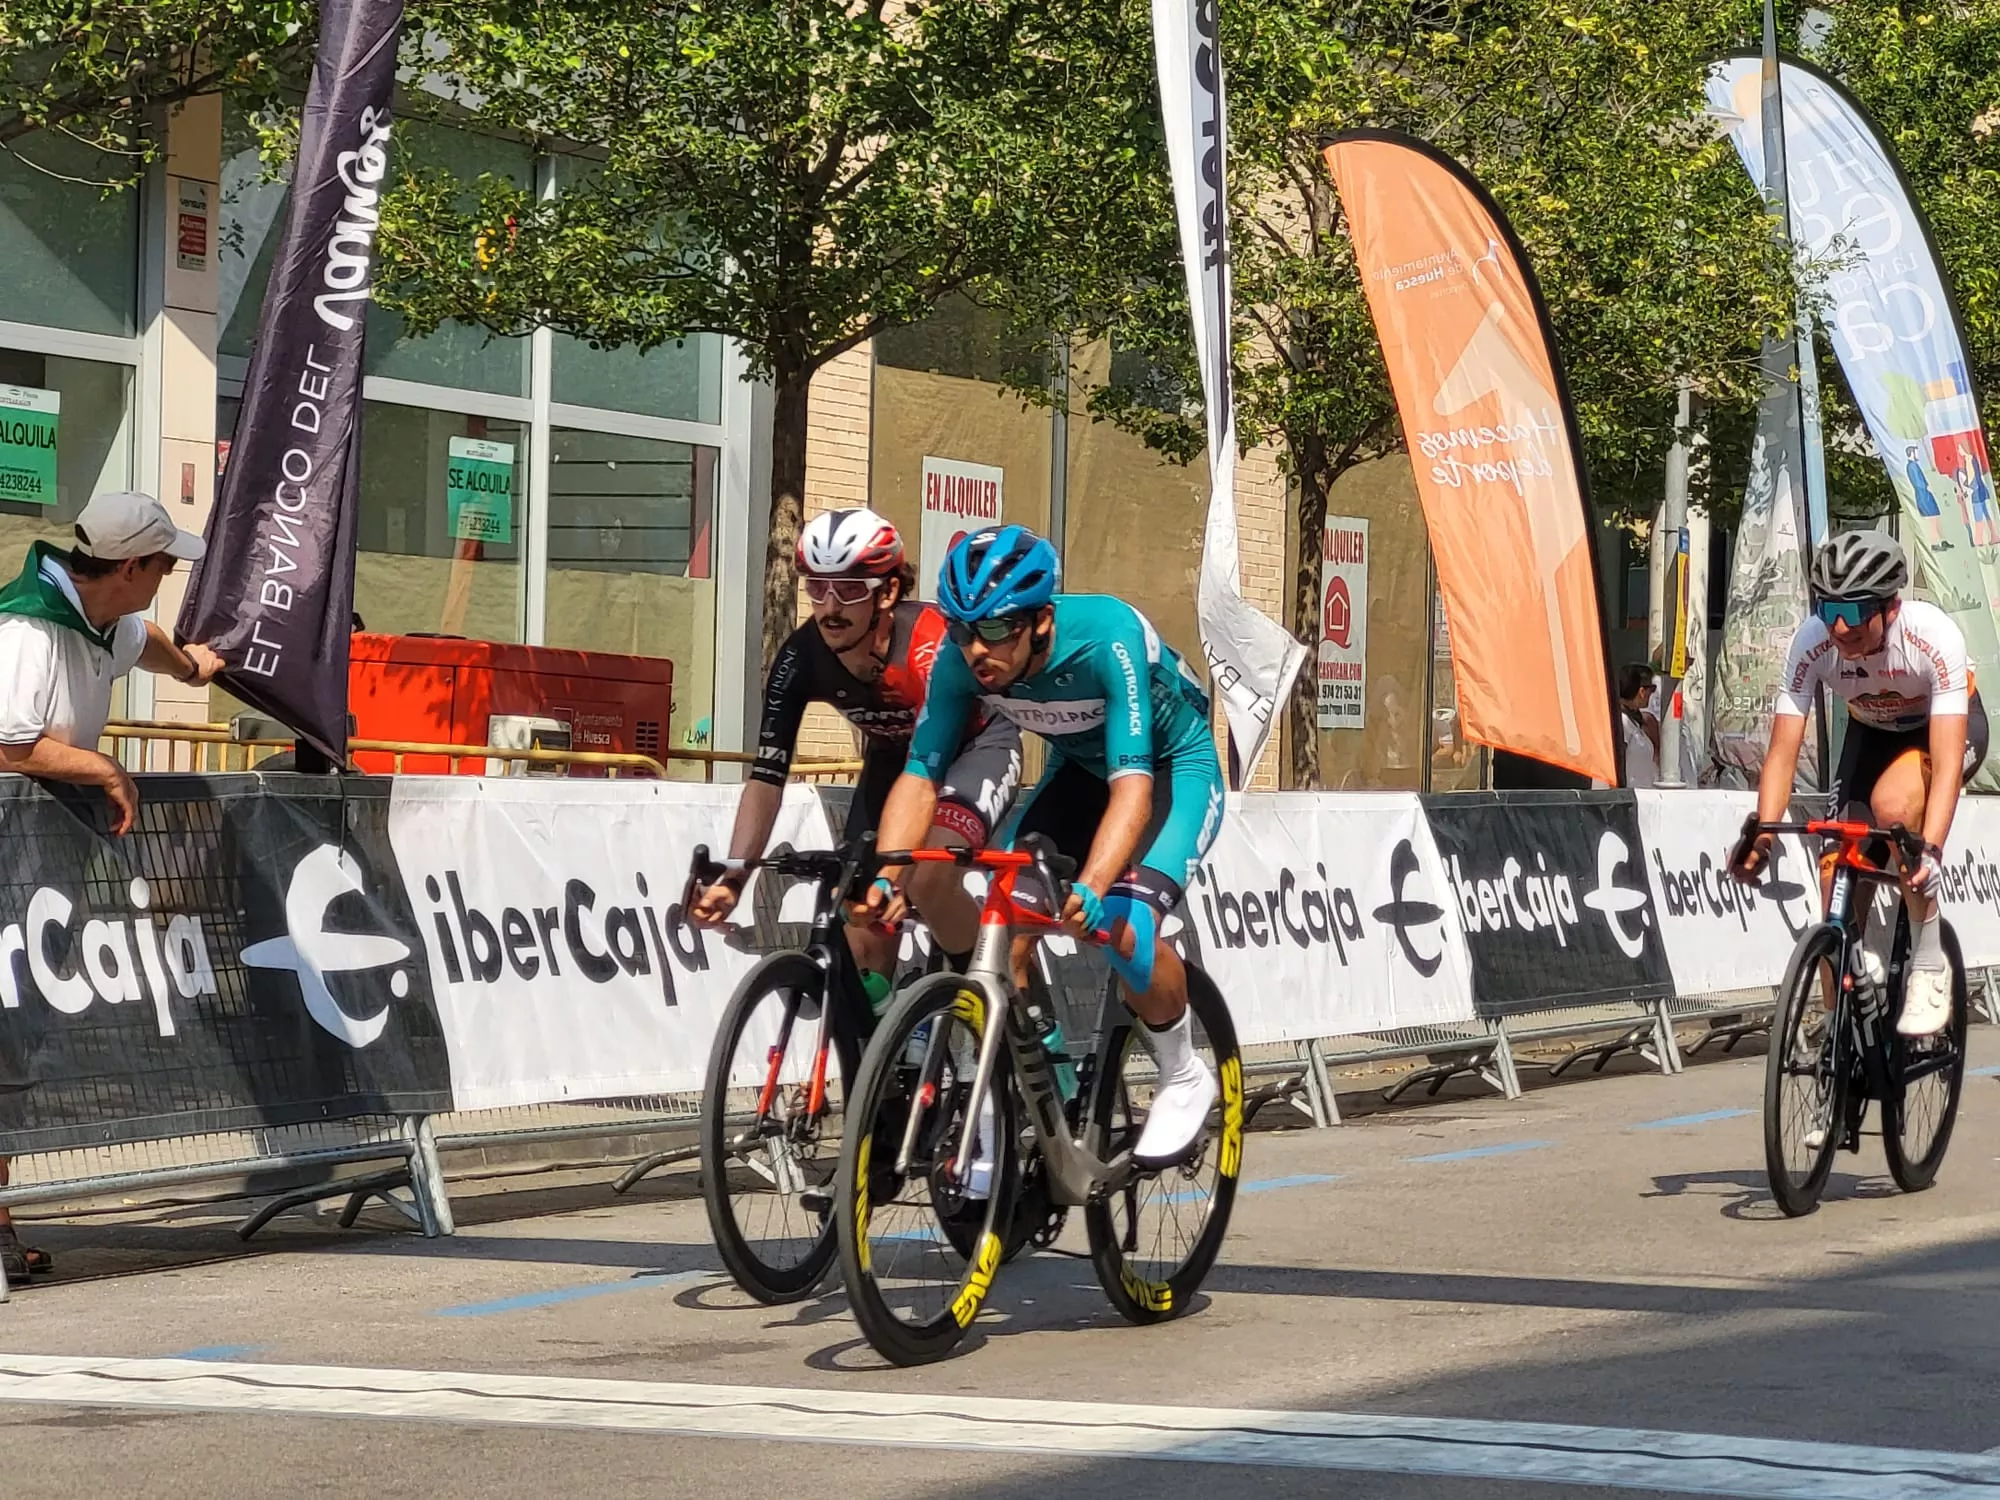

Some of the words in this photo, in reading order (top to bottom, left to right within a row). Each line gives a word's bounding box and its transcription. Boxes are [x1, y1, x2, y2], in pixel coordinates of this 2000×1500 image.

[448, 468, 464, 489] SE
[465, 470, 510, 494] ALQUILA
[926, 472, 941, 511] EN
[943, 474, 997, 520] ALQUILER
[1323, 527, 1364, 566] ALQUILER
[1111, 641, 1143, 737] CONTROLPACK
[583, 731, 611, 745] Huesca
[1196, 862, 1365, 967] iberCaja
[1440, 851, 1579, 947] iberCaja
[425, 870, 710, 1007] iberCaja
